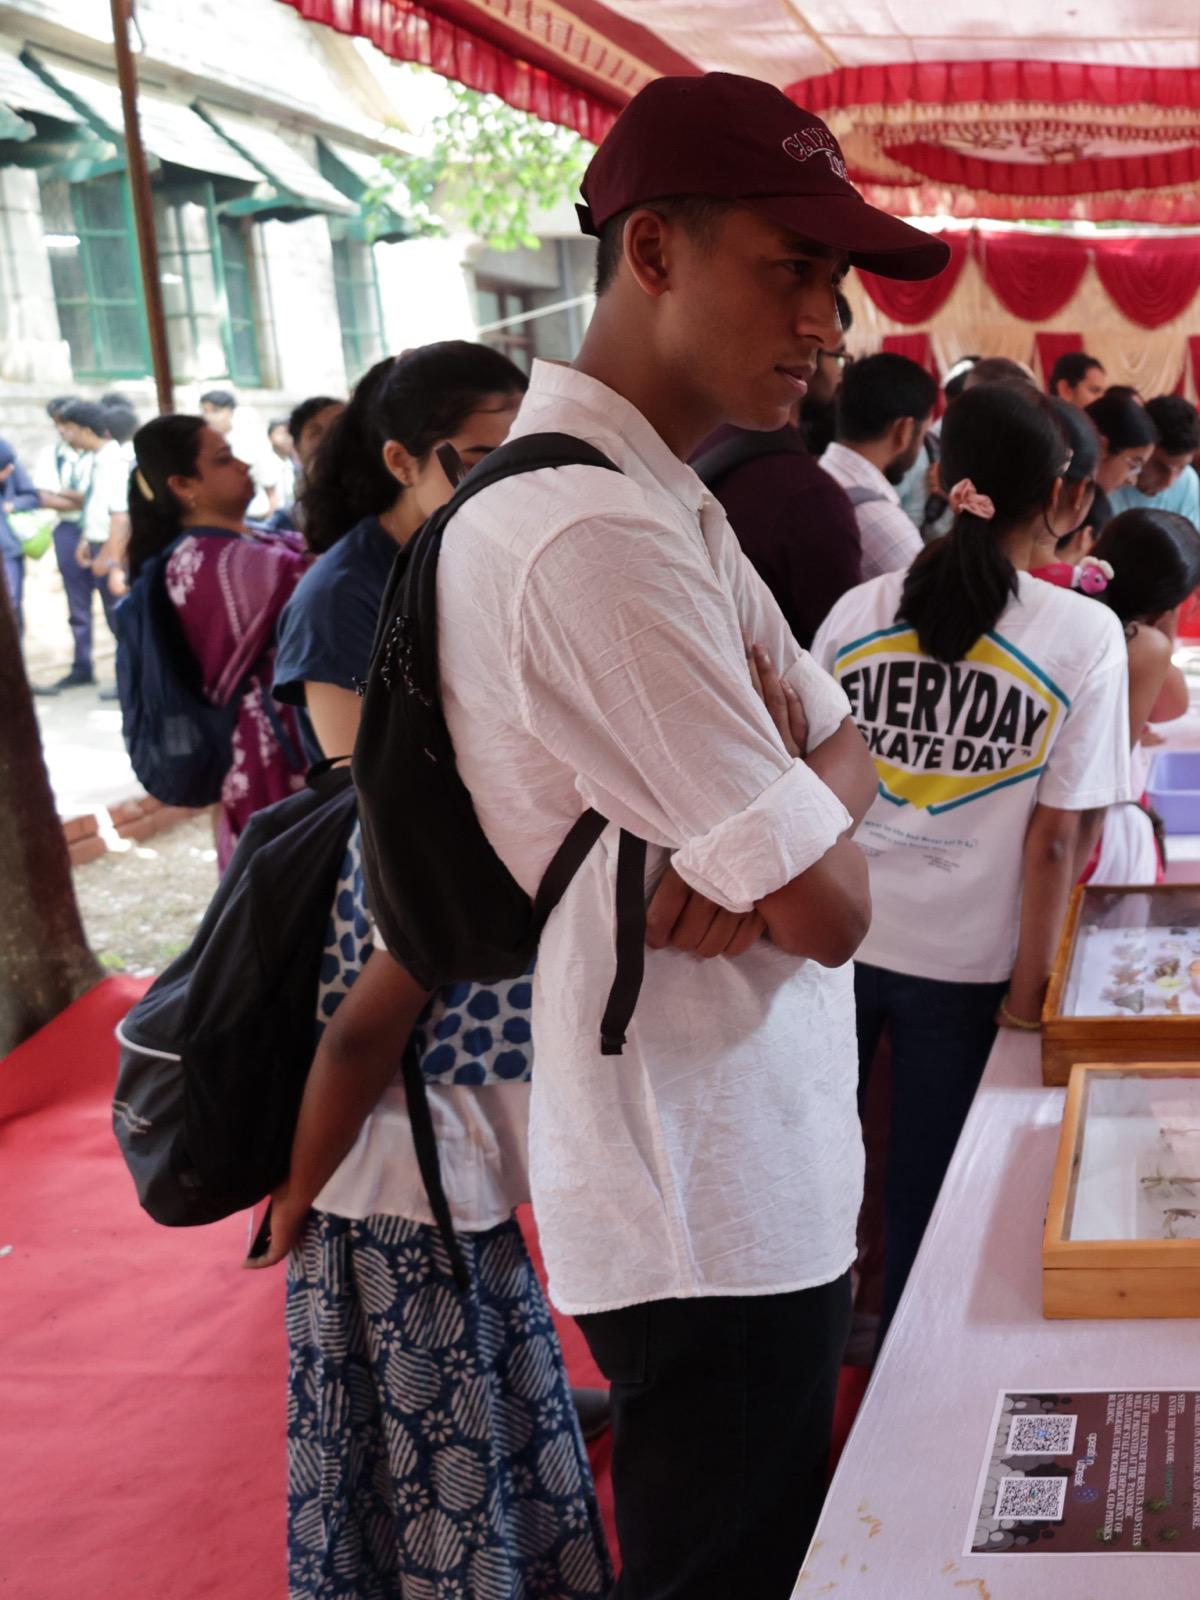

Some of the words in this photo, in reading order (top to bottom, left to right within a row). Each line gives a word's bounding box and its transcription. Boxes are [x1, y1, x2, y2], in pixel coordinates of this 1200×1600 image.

[841, 661, 1048, 747] EVERYDAY
[952, 738, 1015, 772] DAY
[1112, 1393, 1125, 1448] UNDERGRADUATE
[1129, 1419, 1140, 1454] PRESENTED
[1137, 1462, 1146, 1474] THE
[1192, 1475, 1200, 1489] AND
[1105, 1493, 1115, 1509] OLD
[1114, 1475, 1126, 1520] DEPARTMENT
[1135, 1476, 1145, 1505] RESULTS
[1102, 1510, 1113, 1540] PHYSICS
[1133, 1506, 1143, 1521] AND
[1131, 1522, 1142, 1546] STATS
